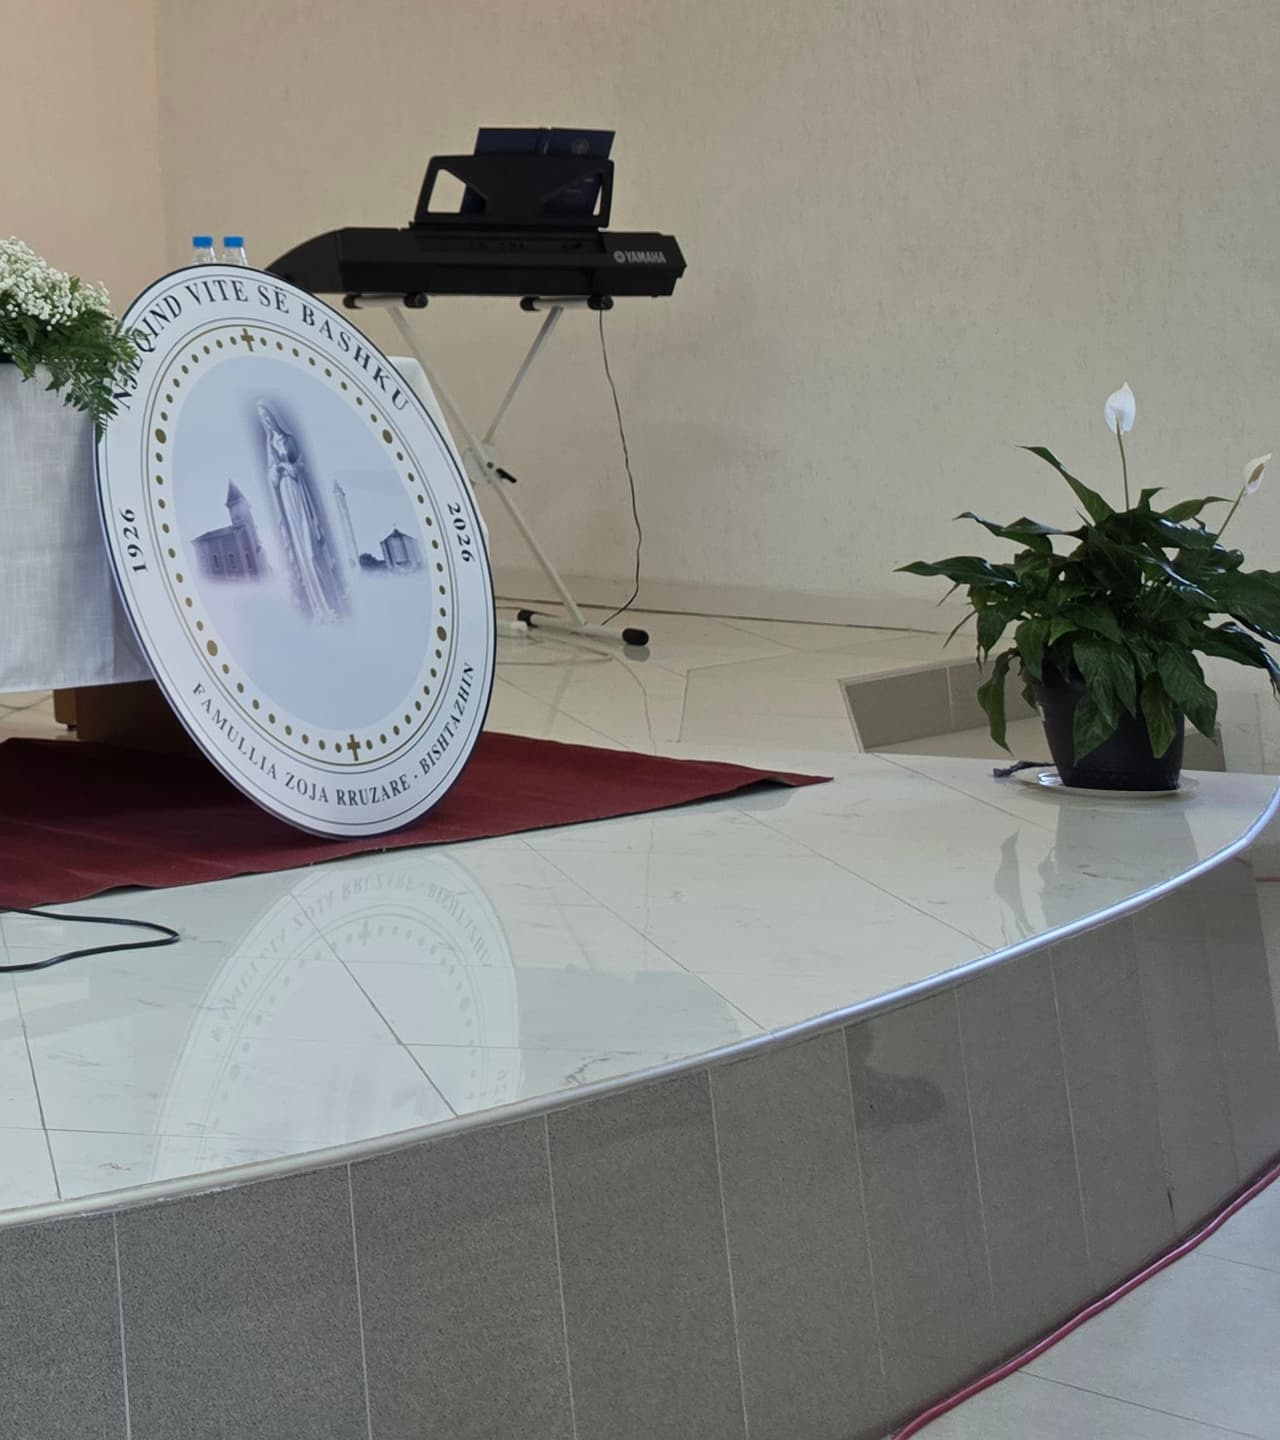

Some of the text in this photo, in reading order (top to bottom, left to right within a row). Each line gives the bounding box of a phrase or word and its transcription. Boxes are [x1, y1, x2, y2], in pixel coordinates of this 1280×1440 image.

[625, 250, 667, 264] YAMAHA
[185, 279, 249, 307] VITE
[257, 285, 291, 314] SË
[301, 303, 409, 411] BASHKU
[121, 507, 147, 573] 1926
[446, 502, 473, 563] 2026
[192, 661, 475, 807] FAMULLIA ZOJA RRUZARE BISHTAZHIN
